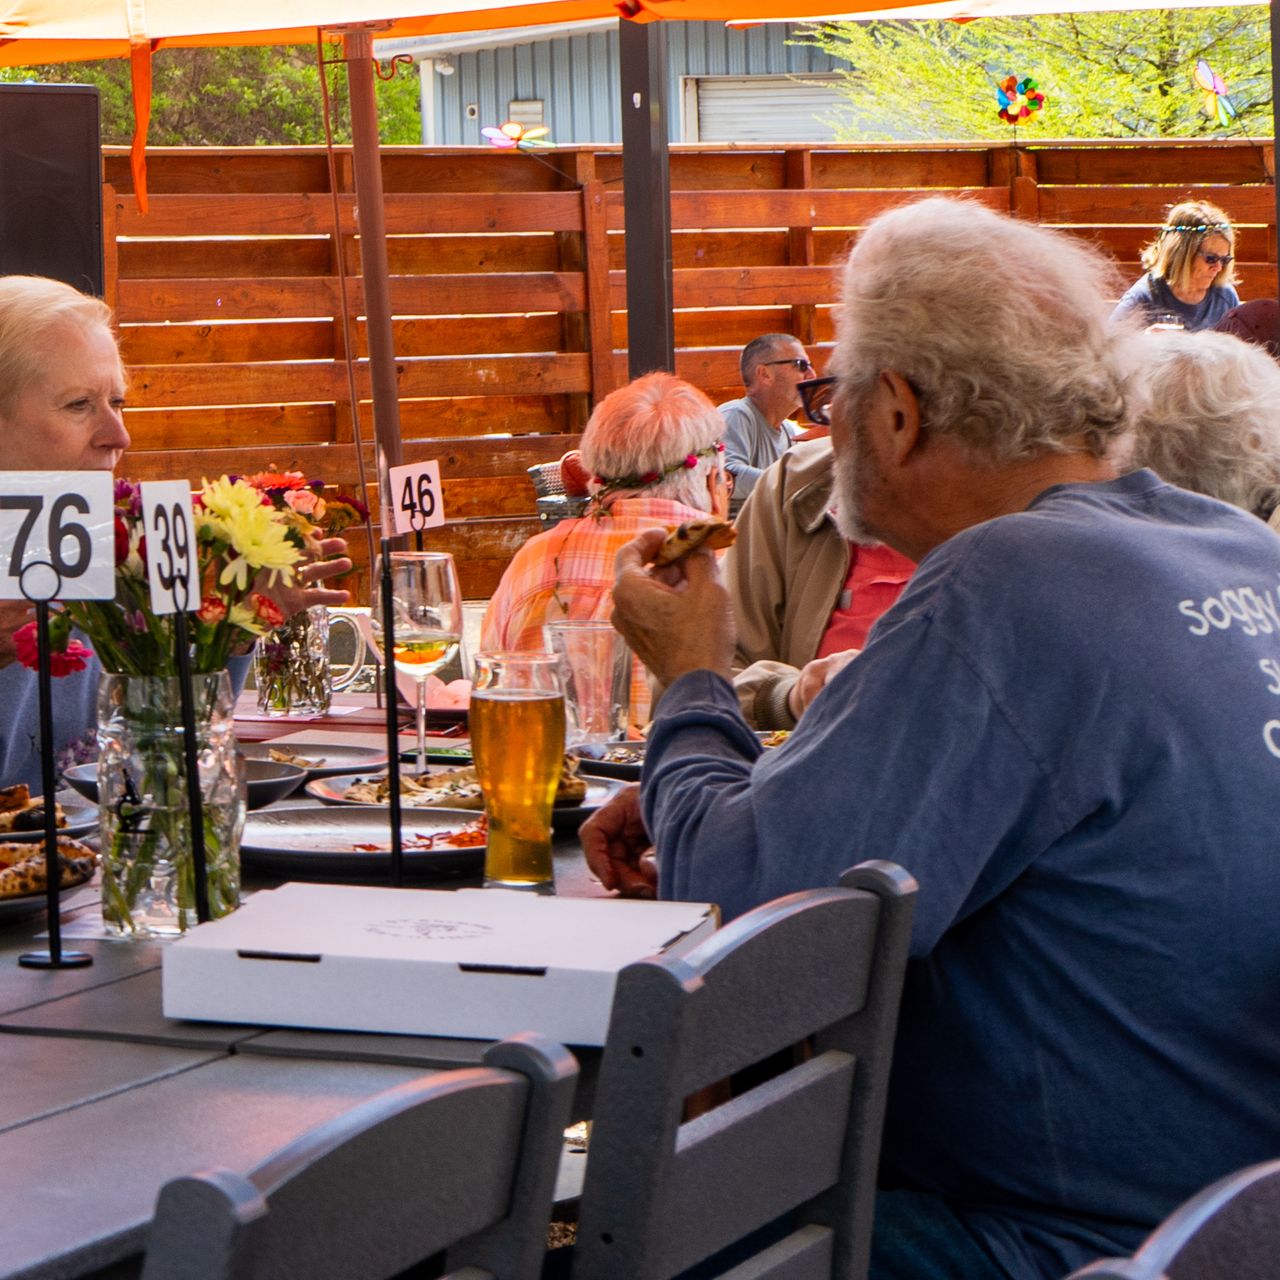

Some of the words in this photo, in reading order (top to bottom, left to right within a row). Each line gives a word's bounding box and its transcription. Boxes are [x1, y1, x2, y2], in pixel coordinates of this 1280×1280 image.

[0, 493, 92, 578] 76
[401, 473, 435, 519] 46
[154, 502, 189, 590] 39
